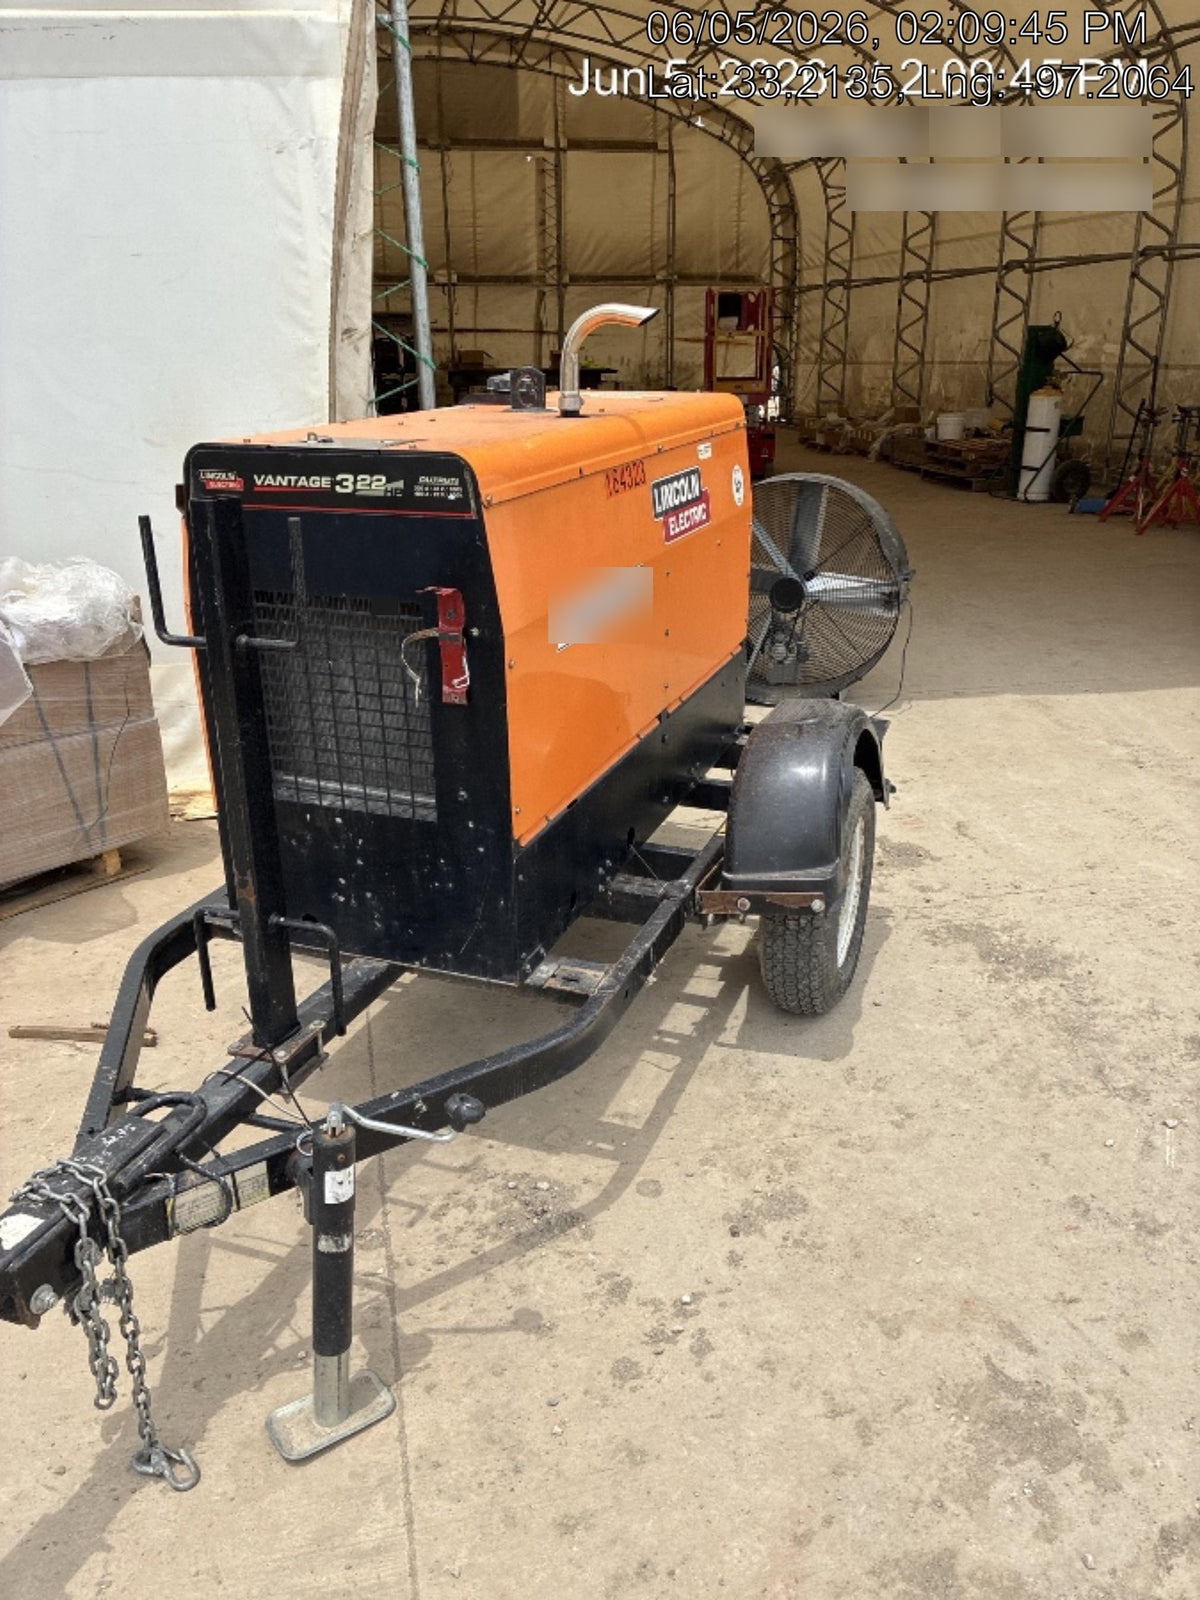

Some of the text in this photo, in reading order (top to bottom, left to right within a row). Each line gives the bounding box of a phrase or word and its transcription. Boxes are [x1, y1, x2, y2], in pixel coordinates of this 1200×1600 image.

[253, 474, 331, 489] VANTAGE
[335, 473, 386, 493] 322
[653, 473, 700, 514] LINCOLN
[668, 502, 707, 537] ELECTRIC
